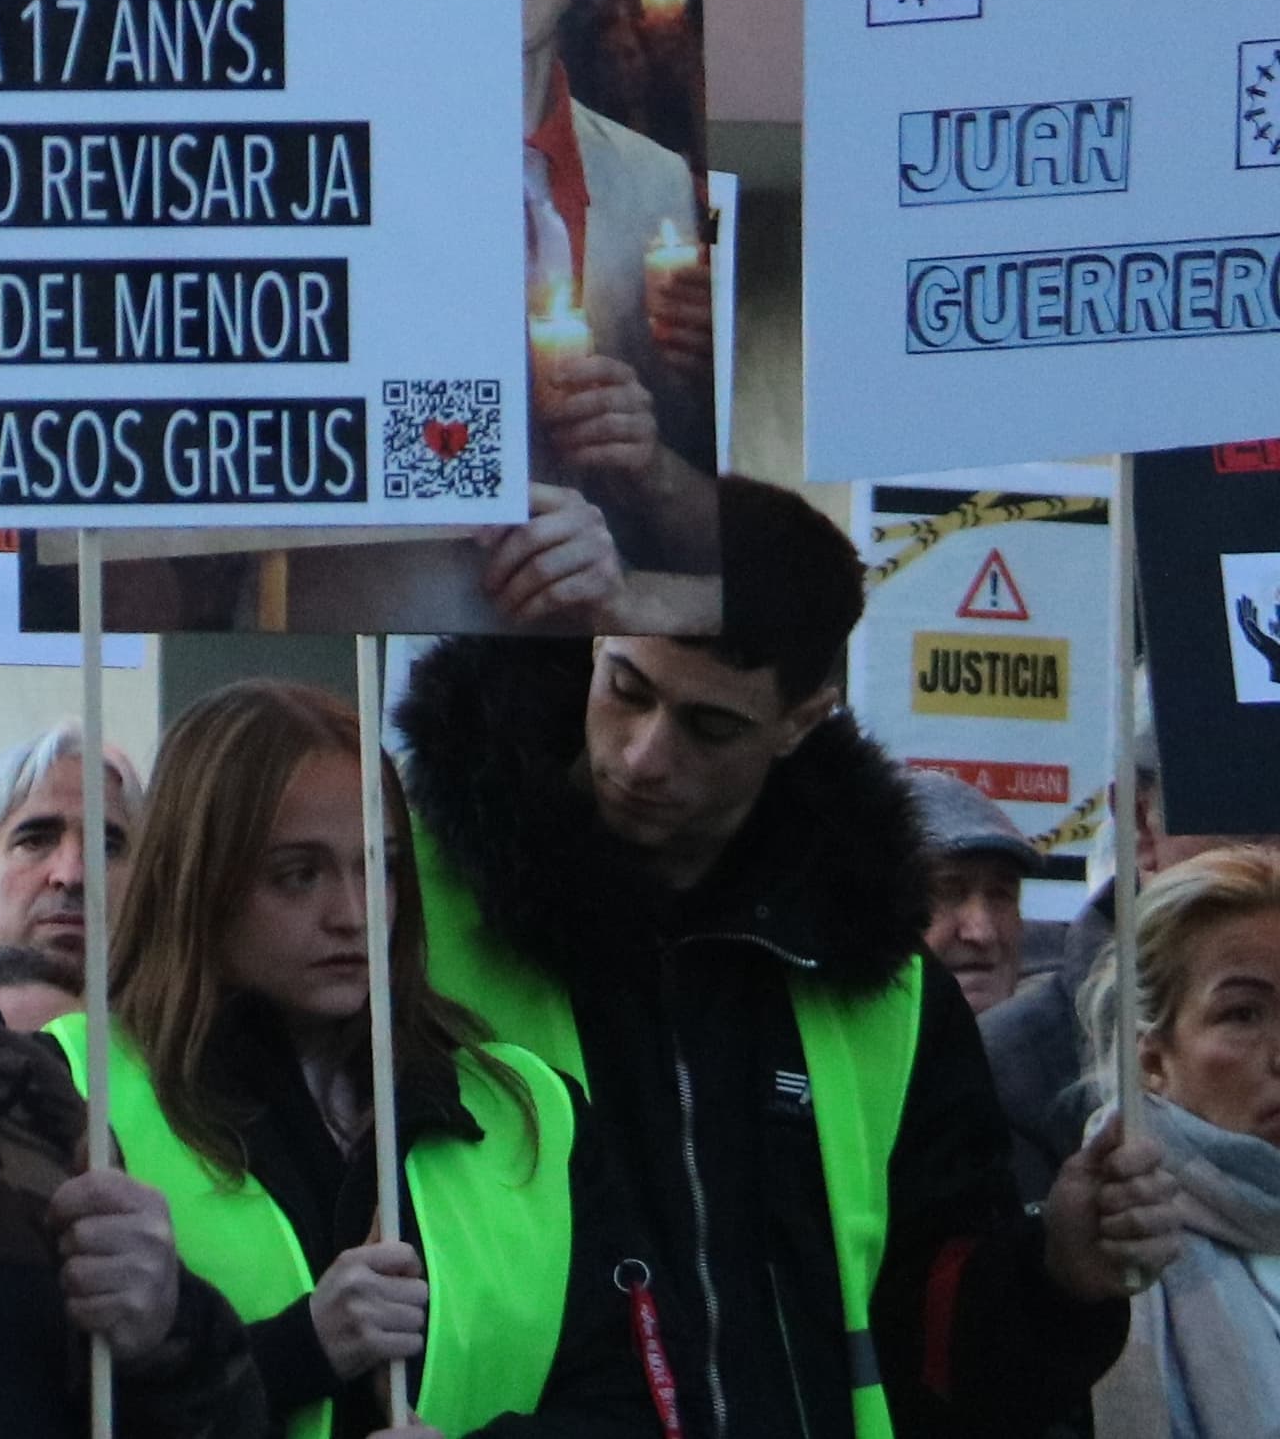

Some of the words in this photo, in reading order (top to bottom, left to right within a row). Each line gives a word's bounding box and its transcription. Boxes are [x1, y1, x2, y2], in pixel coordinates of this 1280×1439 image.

[41, 133, 277, 222] REVISAR
[290, 133, 360, 221] JA
[900, 102, 1130, 195] JUAN
[115, 271, 332, 359] MENOR
[907, 248, 1280, 348] GUERRER
[163, 408, 356, 498] GREUS
[920, 647, 1060, 699] JUSTICIA
[1007, 771, 1064, 794] JUAN
